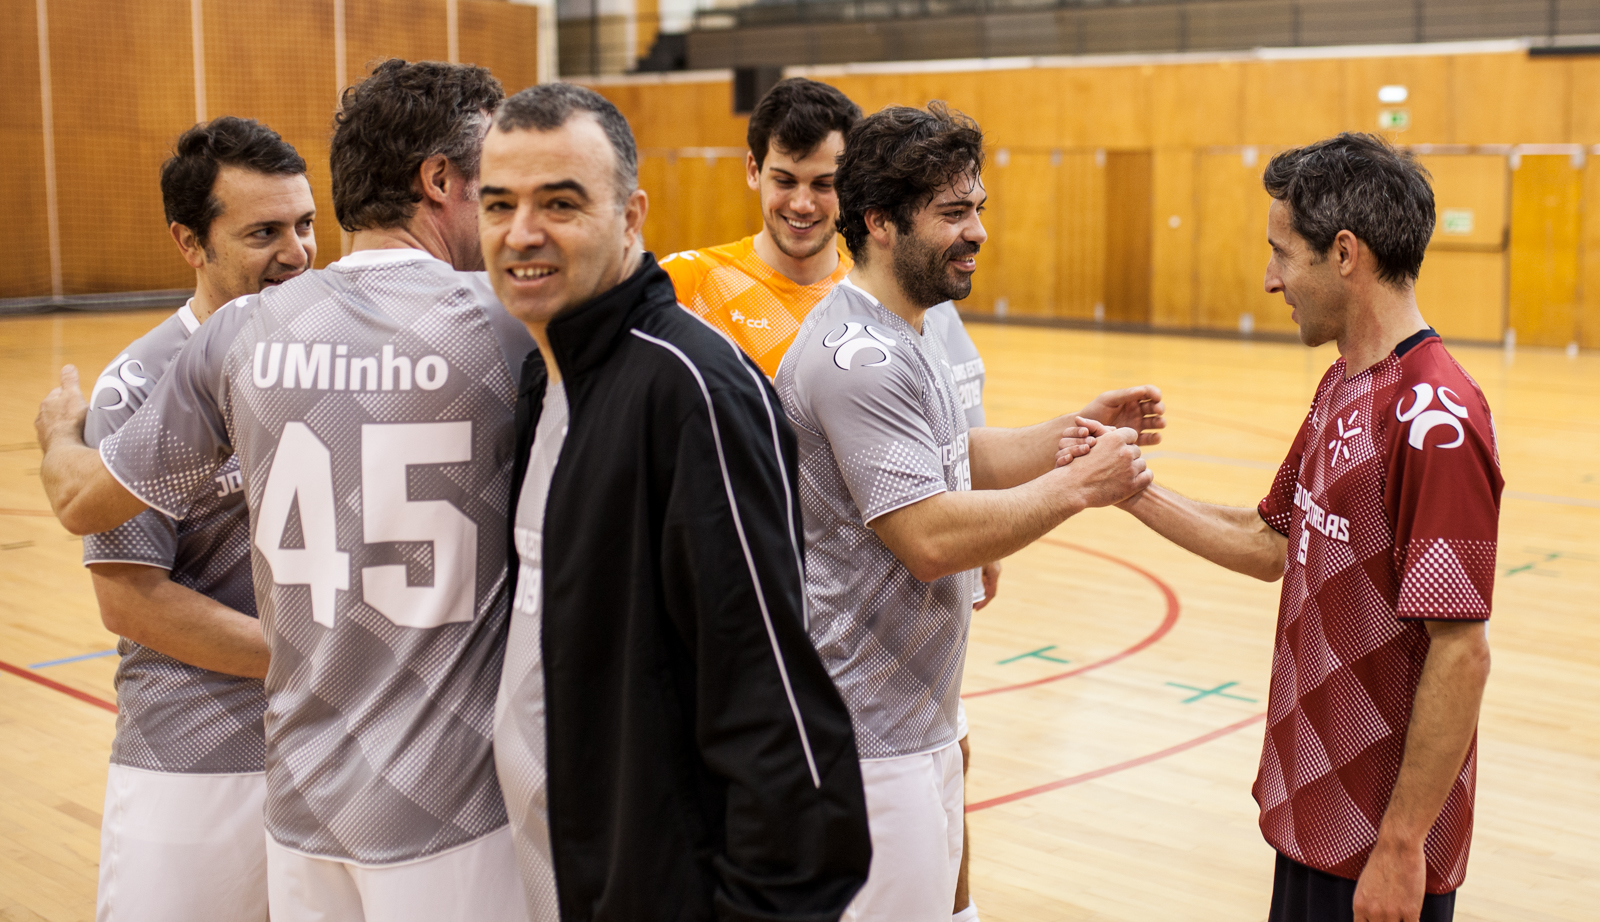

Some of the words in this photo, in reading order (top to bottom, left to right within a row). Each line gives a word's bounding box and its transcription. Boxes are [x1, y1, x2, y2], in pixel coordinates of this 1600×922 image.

[746, 317, 771, 330] cdt
[252, 341, 449, 391] UMinho
[254, 420, 478, 629] 45
